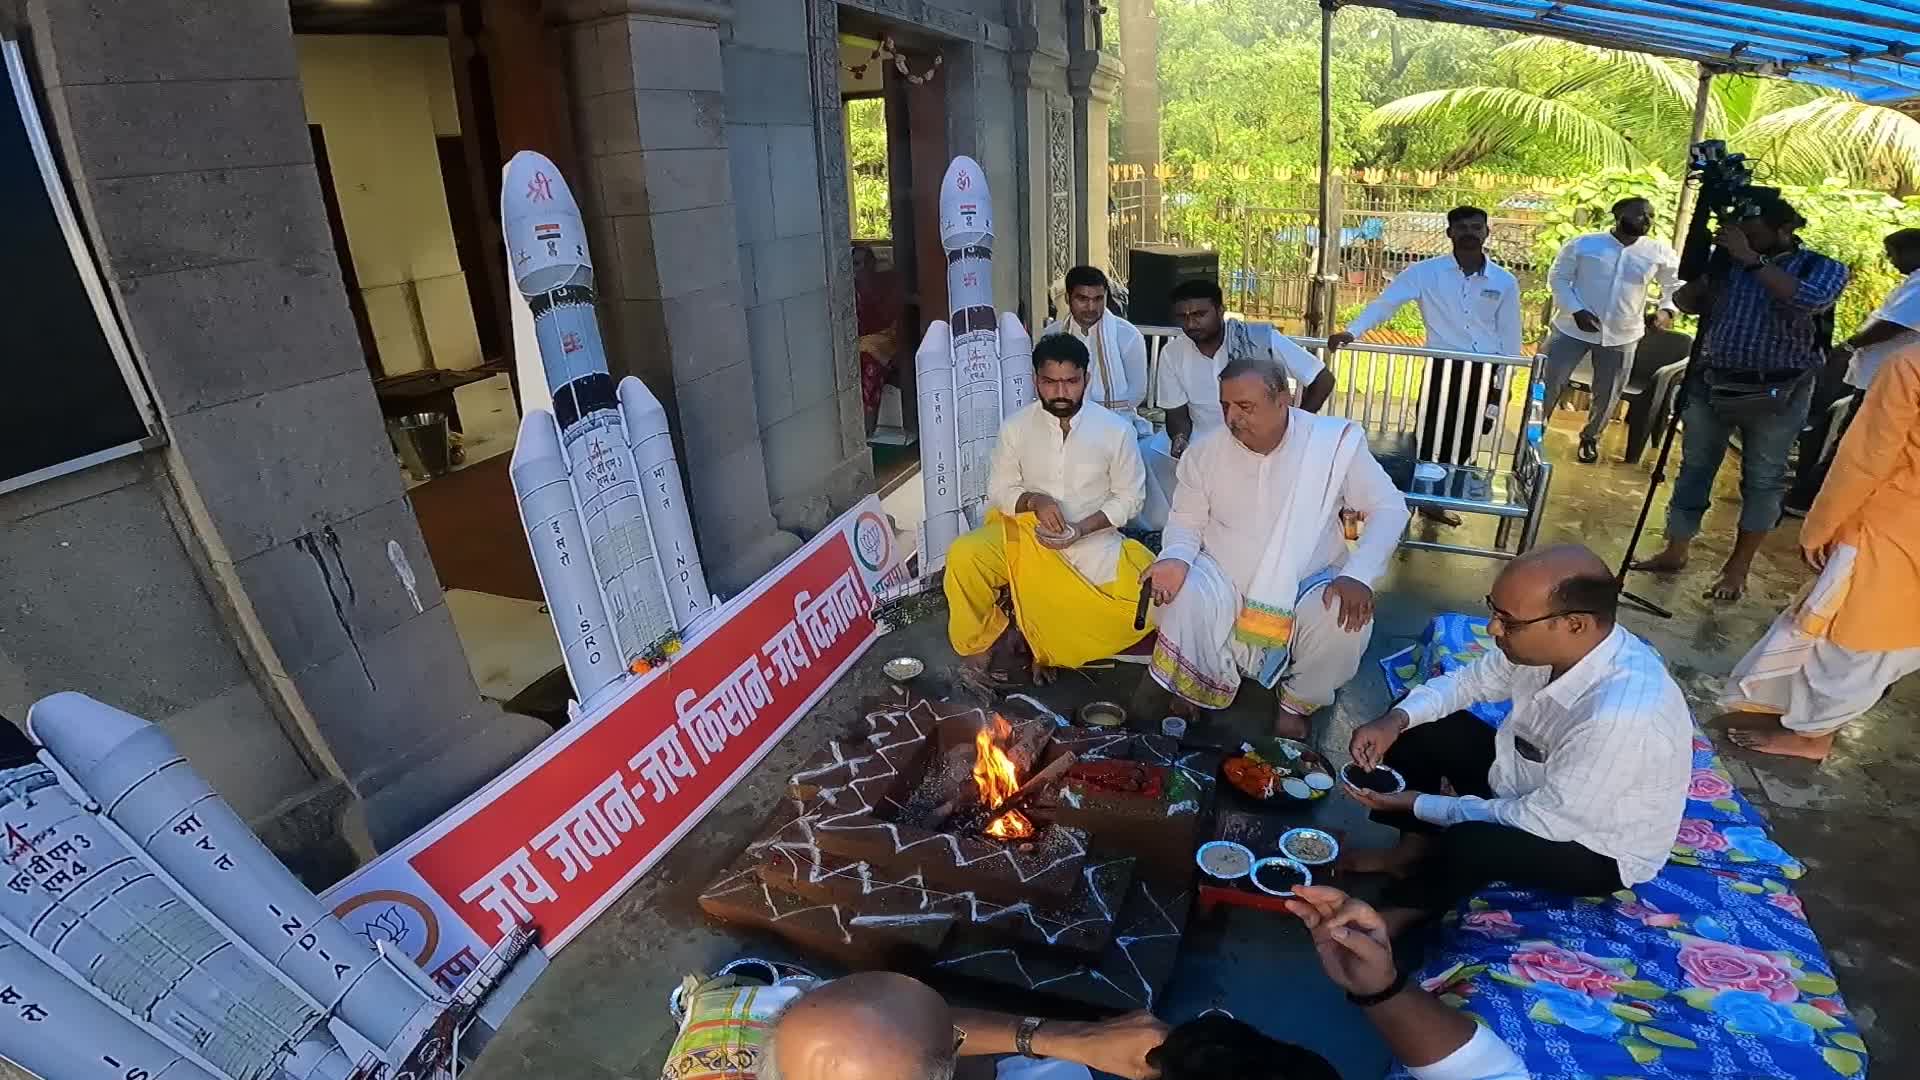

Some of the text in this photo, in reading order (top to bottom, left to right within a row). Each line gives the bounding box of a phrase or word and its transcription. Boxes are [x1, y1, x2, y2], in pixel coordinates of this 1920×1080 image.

[937, 452, 946, 496] ISRO
[675, 542, 698, 612] INDIA
[577, 603, 601, 665] ISRO
[269, 903, 352, 979] INDIA
